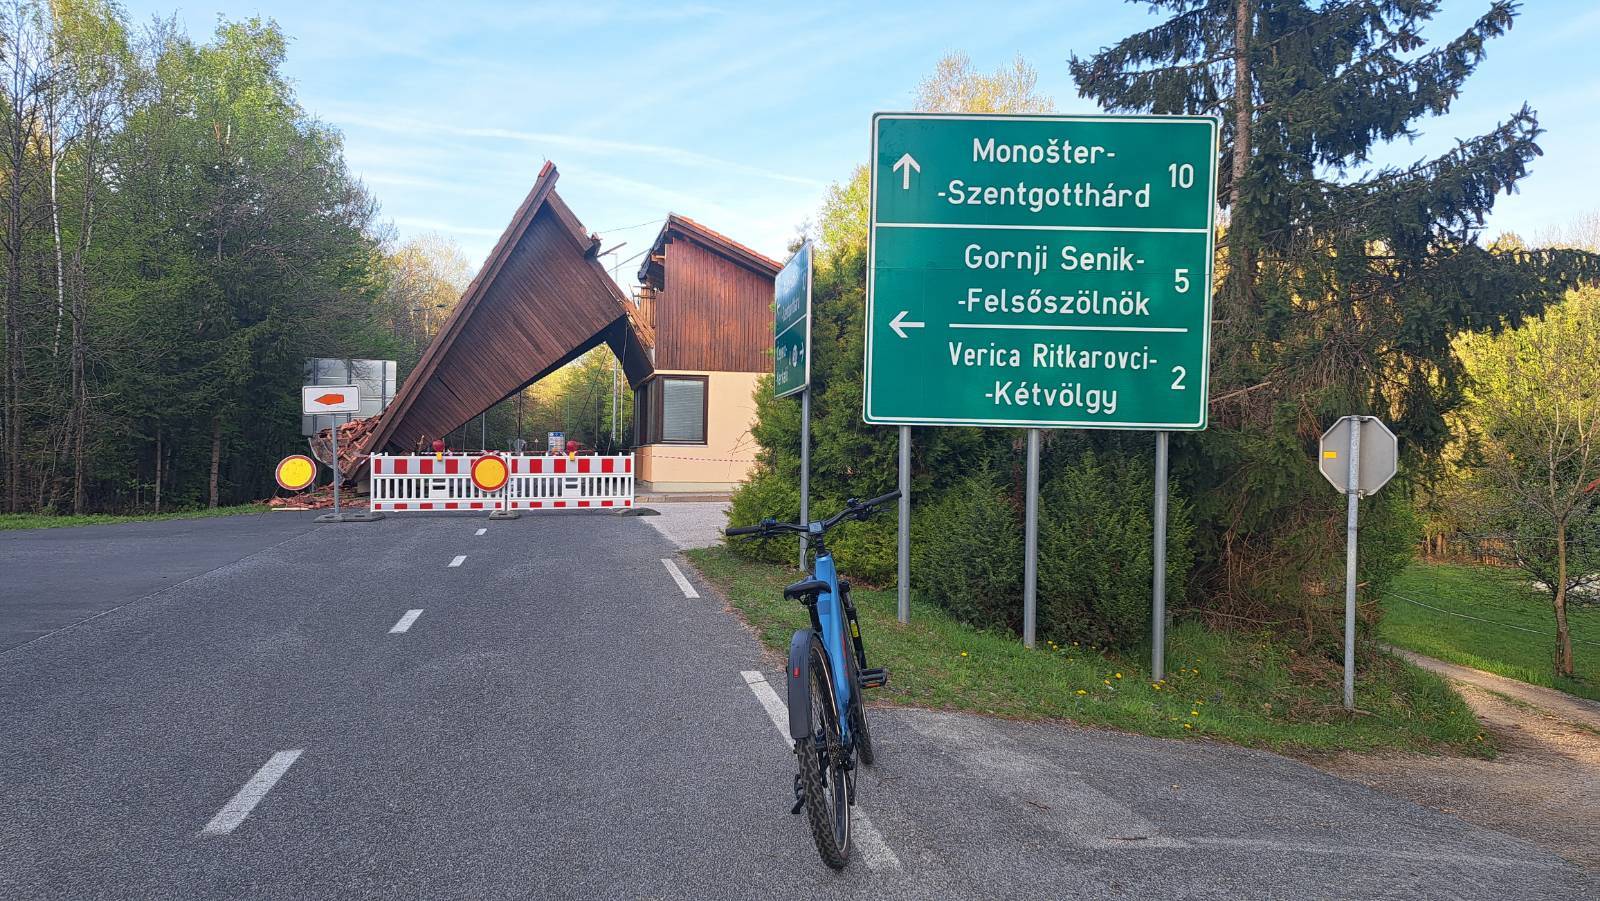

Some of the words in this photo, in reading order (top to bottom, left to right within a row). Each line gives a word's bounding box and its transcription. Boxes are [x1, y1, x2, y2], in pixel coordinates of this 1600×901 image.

[973, 137, 1115, 164] Monošter-
[1168, 163, 1194, 189] 10
[937, 179, 1150, 212] -Szentgotthárd
[964, 243, 1047, 276] Gornji
[1060, 245, 1145, 271] Senik-
[1174, 268, 1190, 293] 5
[958, 288, 1150, 316] -Felsőszölnök
[948, 341, 1020, 367] Verica
[1033, 343, 1158, 370] Ritkarovci-
[1171, 365, 1186, 390] 2
[985, 380, 1117, 415] -Kétvölgy
